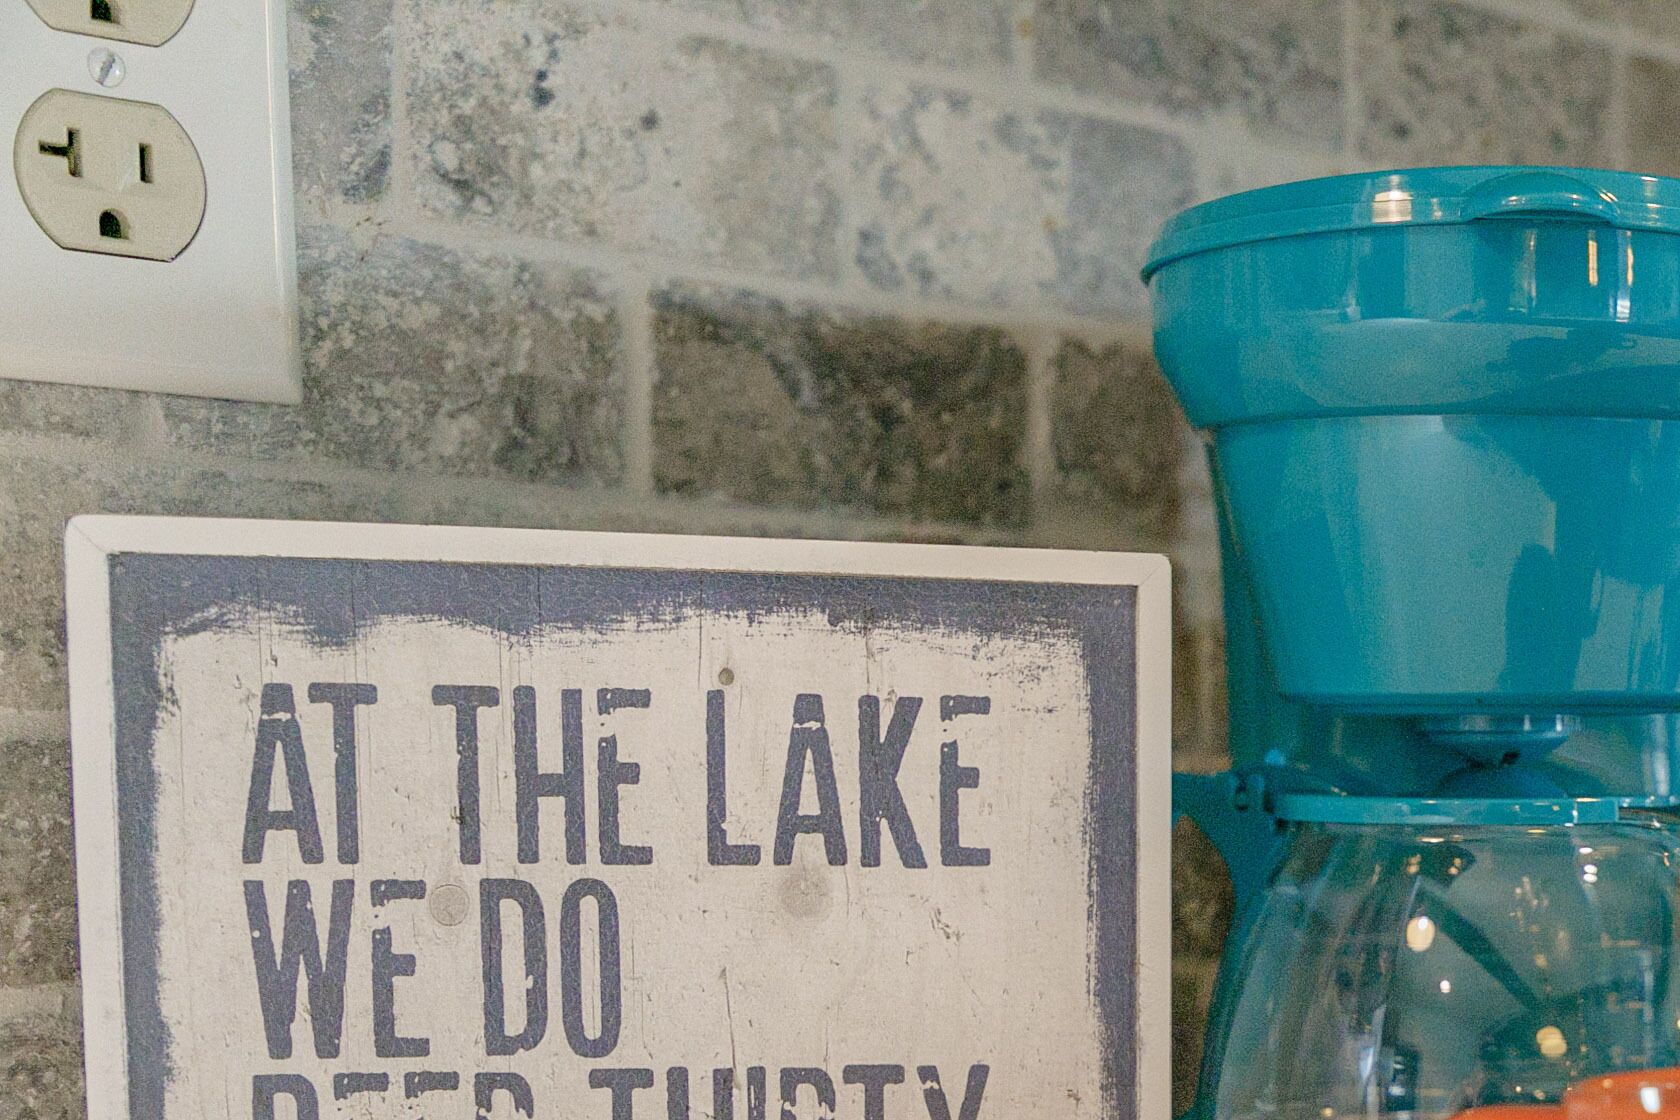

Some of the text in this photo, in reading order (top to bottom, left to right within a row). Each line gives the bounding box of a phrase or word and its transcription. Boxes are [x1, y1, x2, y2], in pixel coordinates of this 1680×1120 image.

[242, 683, 991, 868] AT THE LAKE
[244, 878, 622, 1059] WE DO
